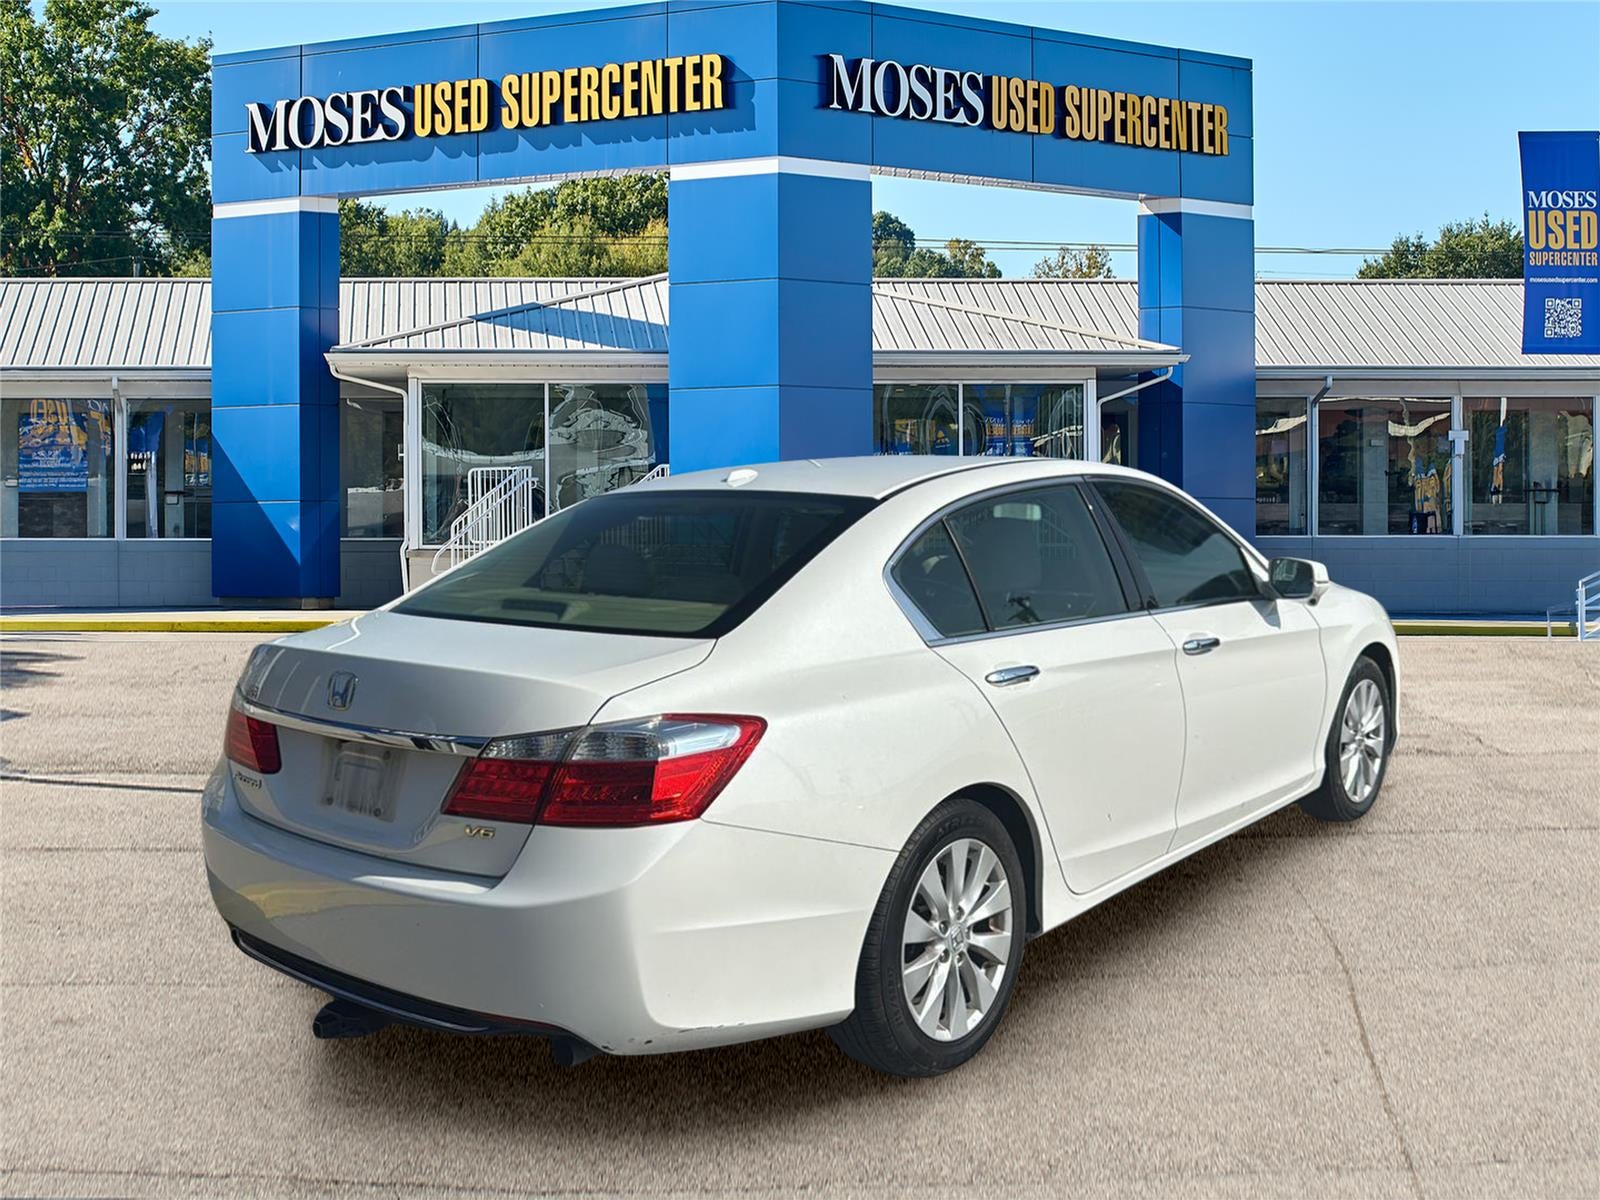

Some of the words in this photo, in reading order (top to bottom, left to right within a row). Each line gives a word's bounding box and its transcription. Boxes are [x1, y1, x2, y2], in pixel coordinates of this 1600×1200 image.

[244, 86, 408, 154] MOSES
[413, 78, 489, 138] USED
[501, 53, 724, 130] SUPERCENTER
[829, 54, 985, 127] MOSES
[990, 75, 1055, 135] USED
[1065, 84, 1230, 156] SUPERCENTER
[1527, 190, 1597, 209] MOSES
[1528, 210, 1598, 250] USED
[1529, 251, 1598, 266] SUPERCENTER
[464, 824, 496, 839] V6
